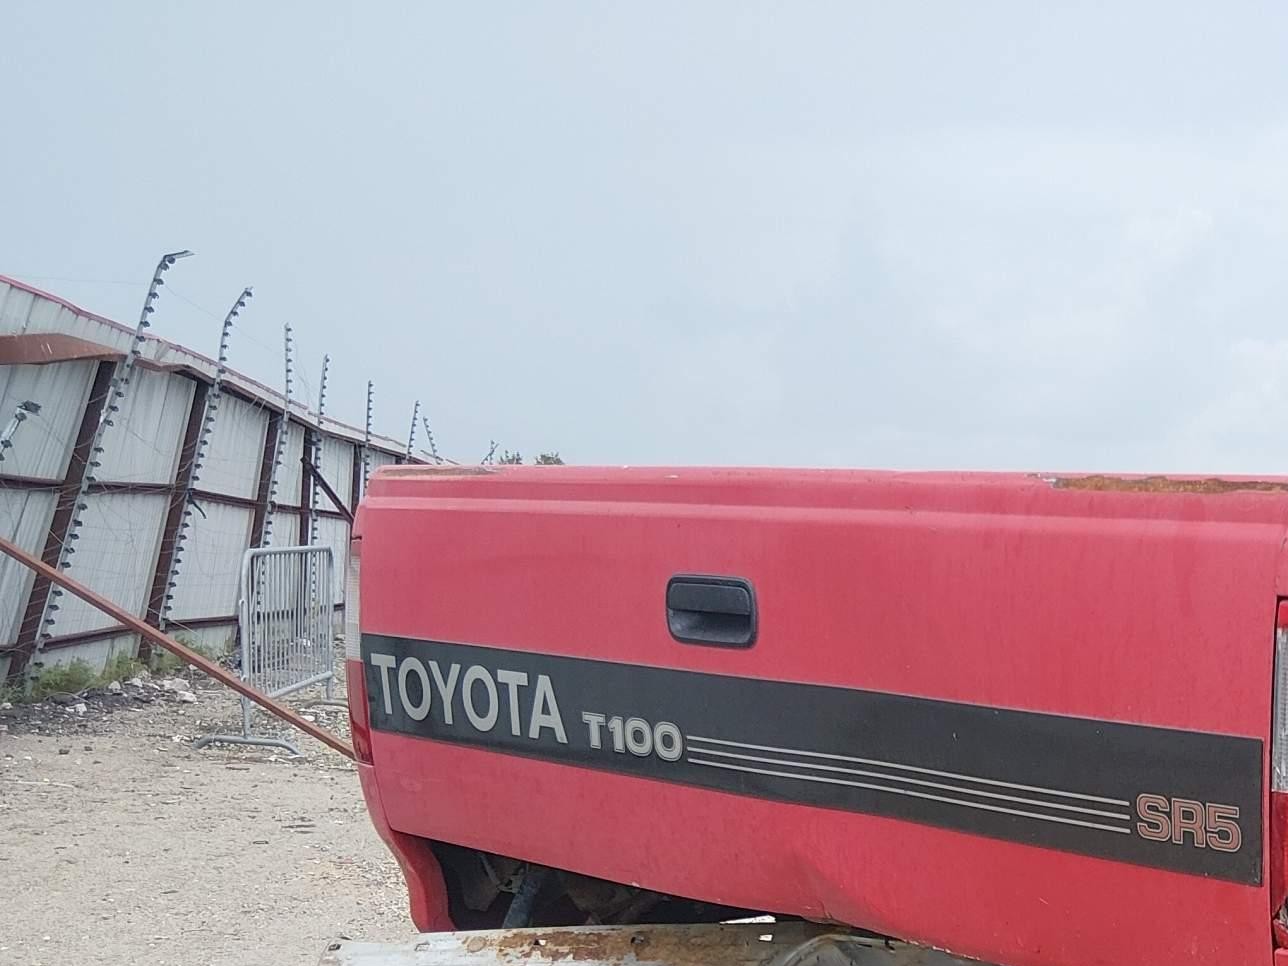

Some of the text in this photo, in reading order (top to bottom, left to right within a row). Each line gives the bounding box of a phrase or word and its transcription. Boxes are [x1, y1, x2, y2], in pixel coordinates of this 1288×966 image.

[370, 652, 1242, 853] TOYOTA T100 SR5
